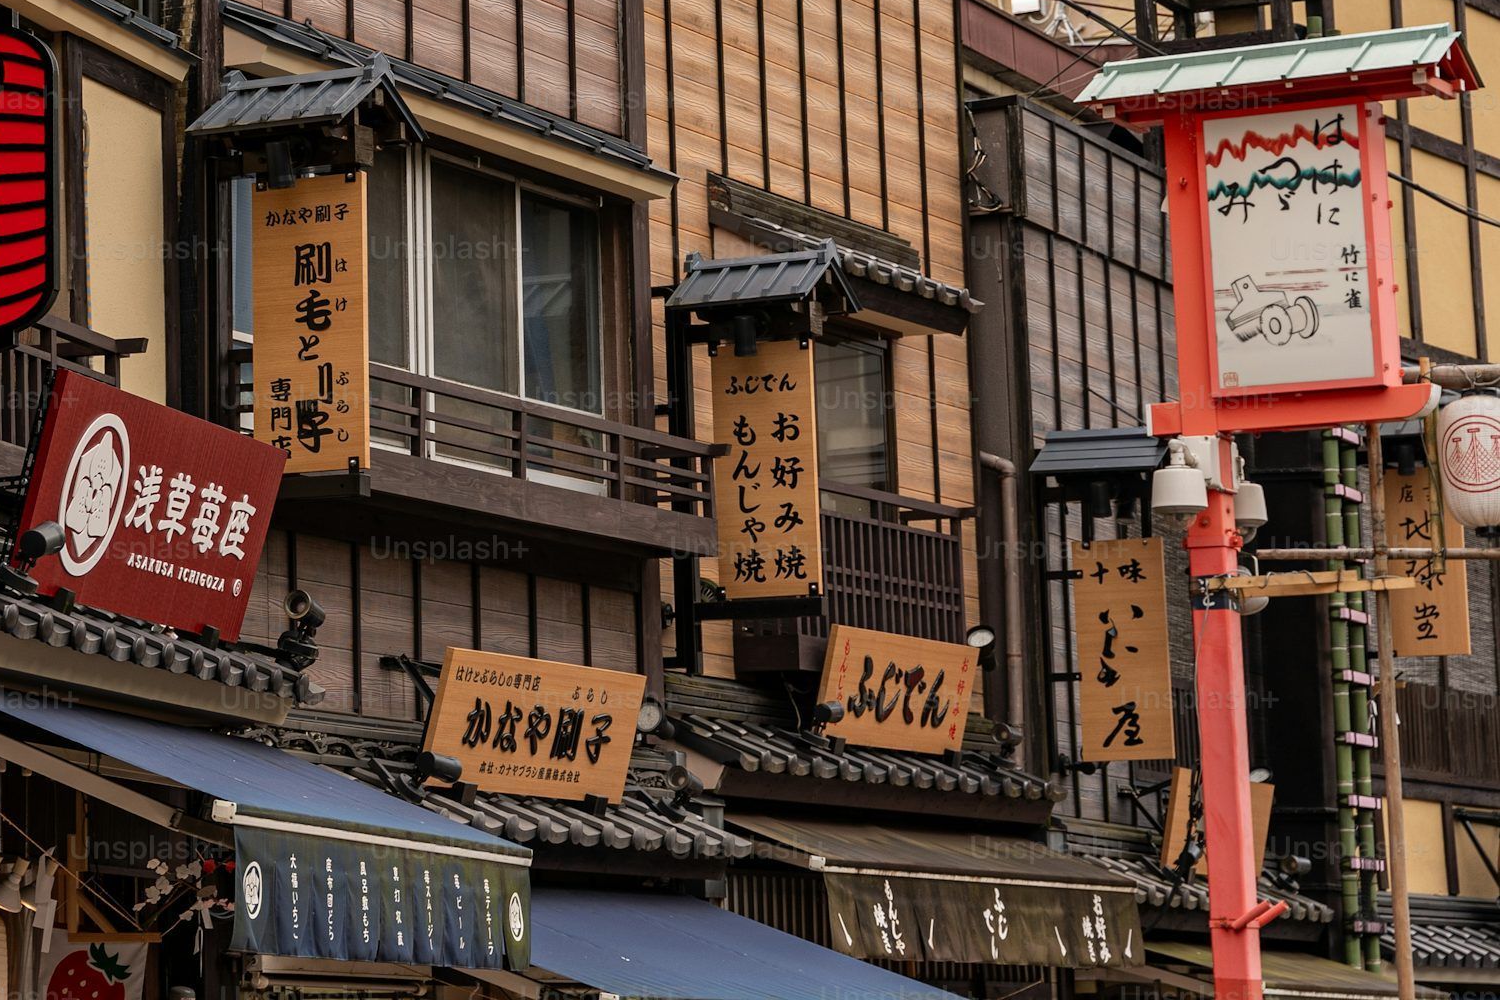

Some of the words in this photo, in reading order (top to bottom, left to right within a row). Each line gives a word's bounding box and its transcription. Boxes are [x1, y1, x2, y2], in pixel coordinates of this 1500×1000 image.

[265, 203, 350, 228] かなや刷子
[725, 373, 798, 396] ふじでん
[270, 377, 293, 460] 専門店
[124, 464, 257, 561] 浅草苺座
[770, 412, 808, 582] お好み焼
[127, 552, 175, 579] ASAKUSA
[177, 566, 226, 592] ICHIGOZA
[455, 665, 542, 692] はけとぶらしの専門店
[571, 685, 608, 705] ぶらし
[848, 654, 951, 729] ふじでん
[461, 696, 613, 766] かなや刷子
